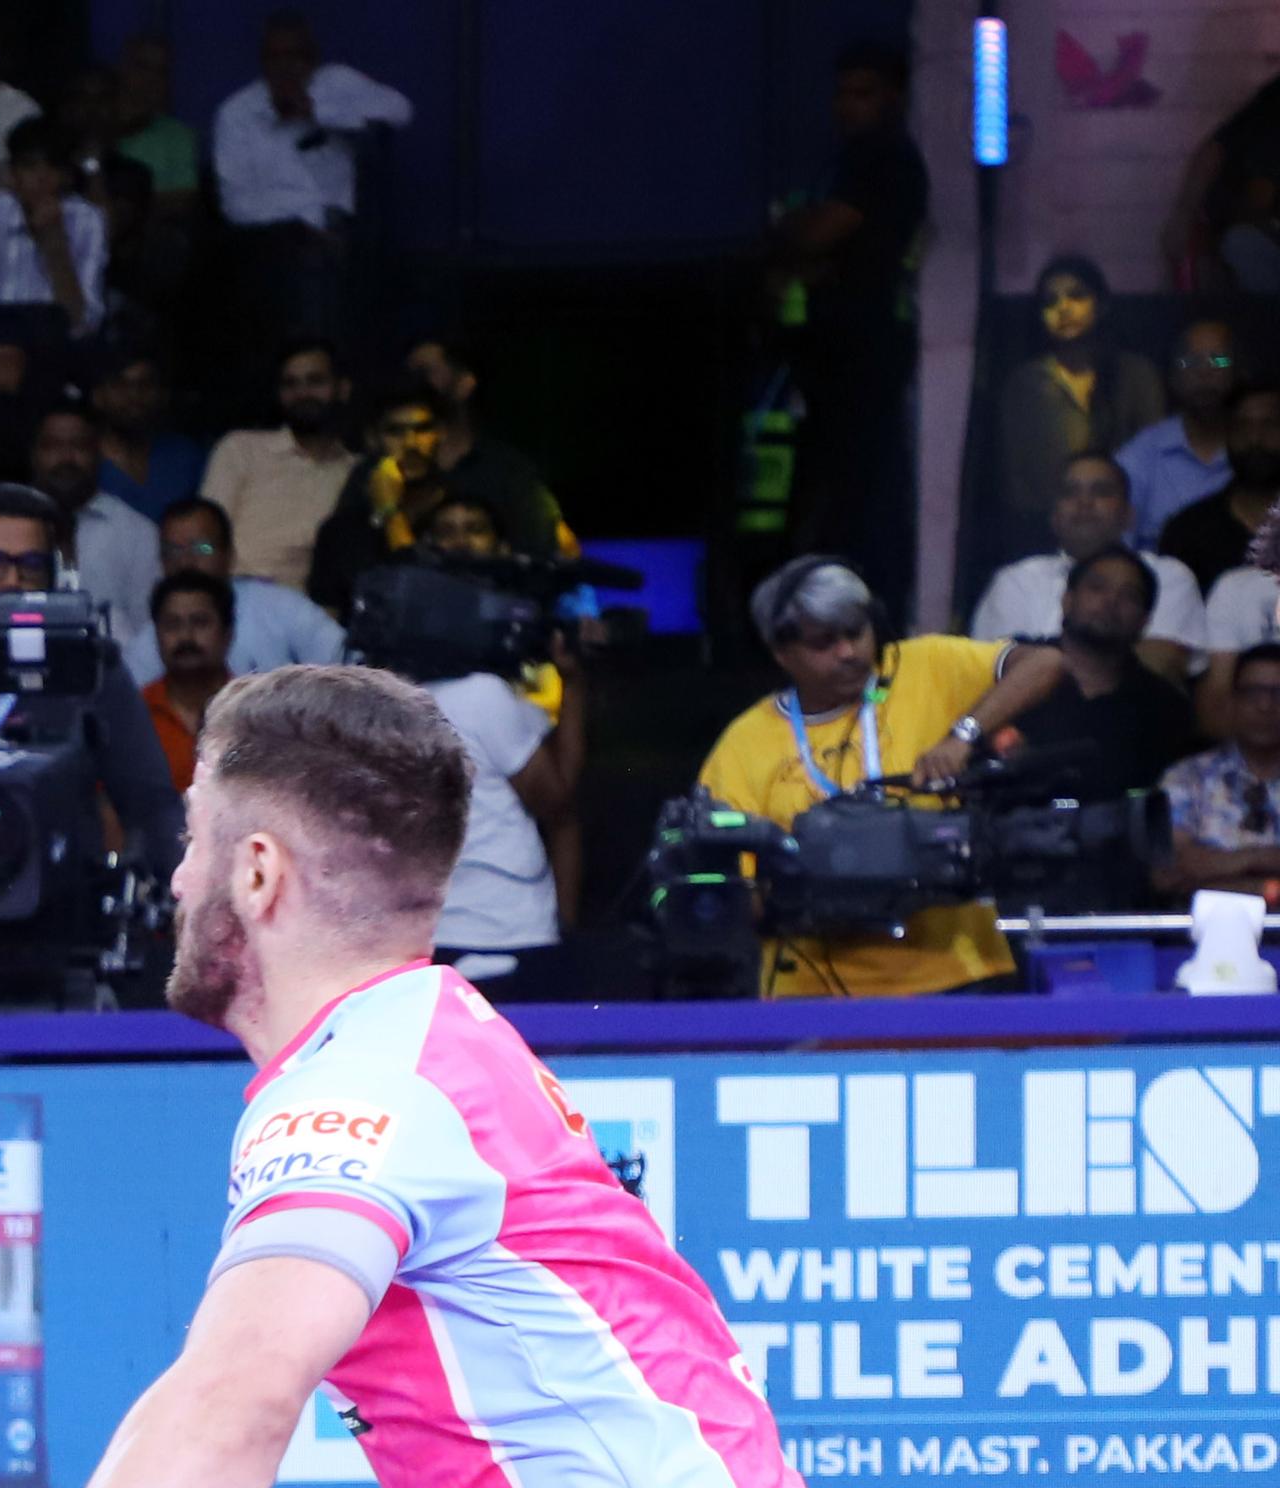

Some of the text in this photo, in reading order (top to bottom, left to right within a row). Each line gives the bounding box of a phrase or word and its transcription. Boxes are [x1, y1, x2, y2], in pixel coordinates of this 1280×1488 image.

[717, 1066, 1280, 1220] TILES
[718, 1247, 972, 1302] WHITE
[726, 1315, 1280, 1400] TILE ADH
[898, 1434, 1050, 1476] MAST.
[1063, 1432, 1278, 1473] PAKKAD
